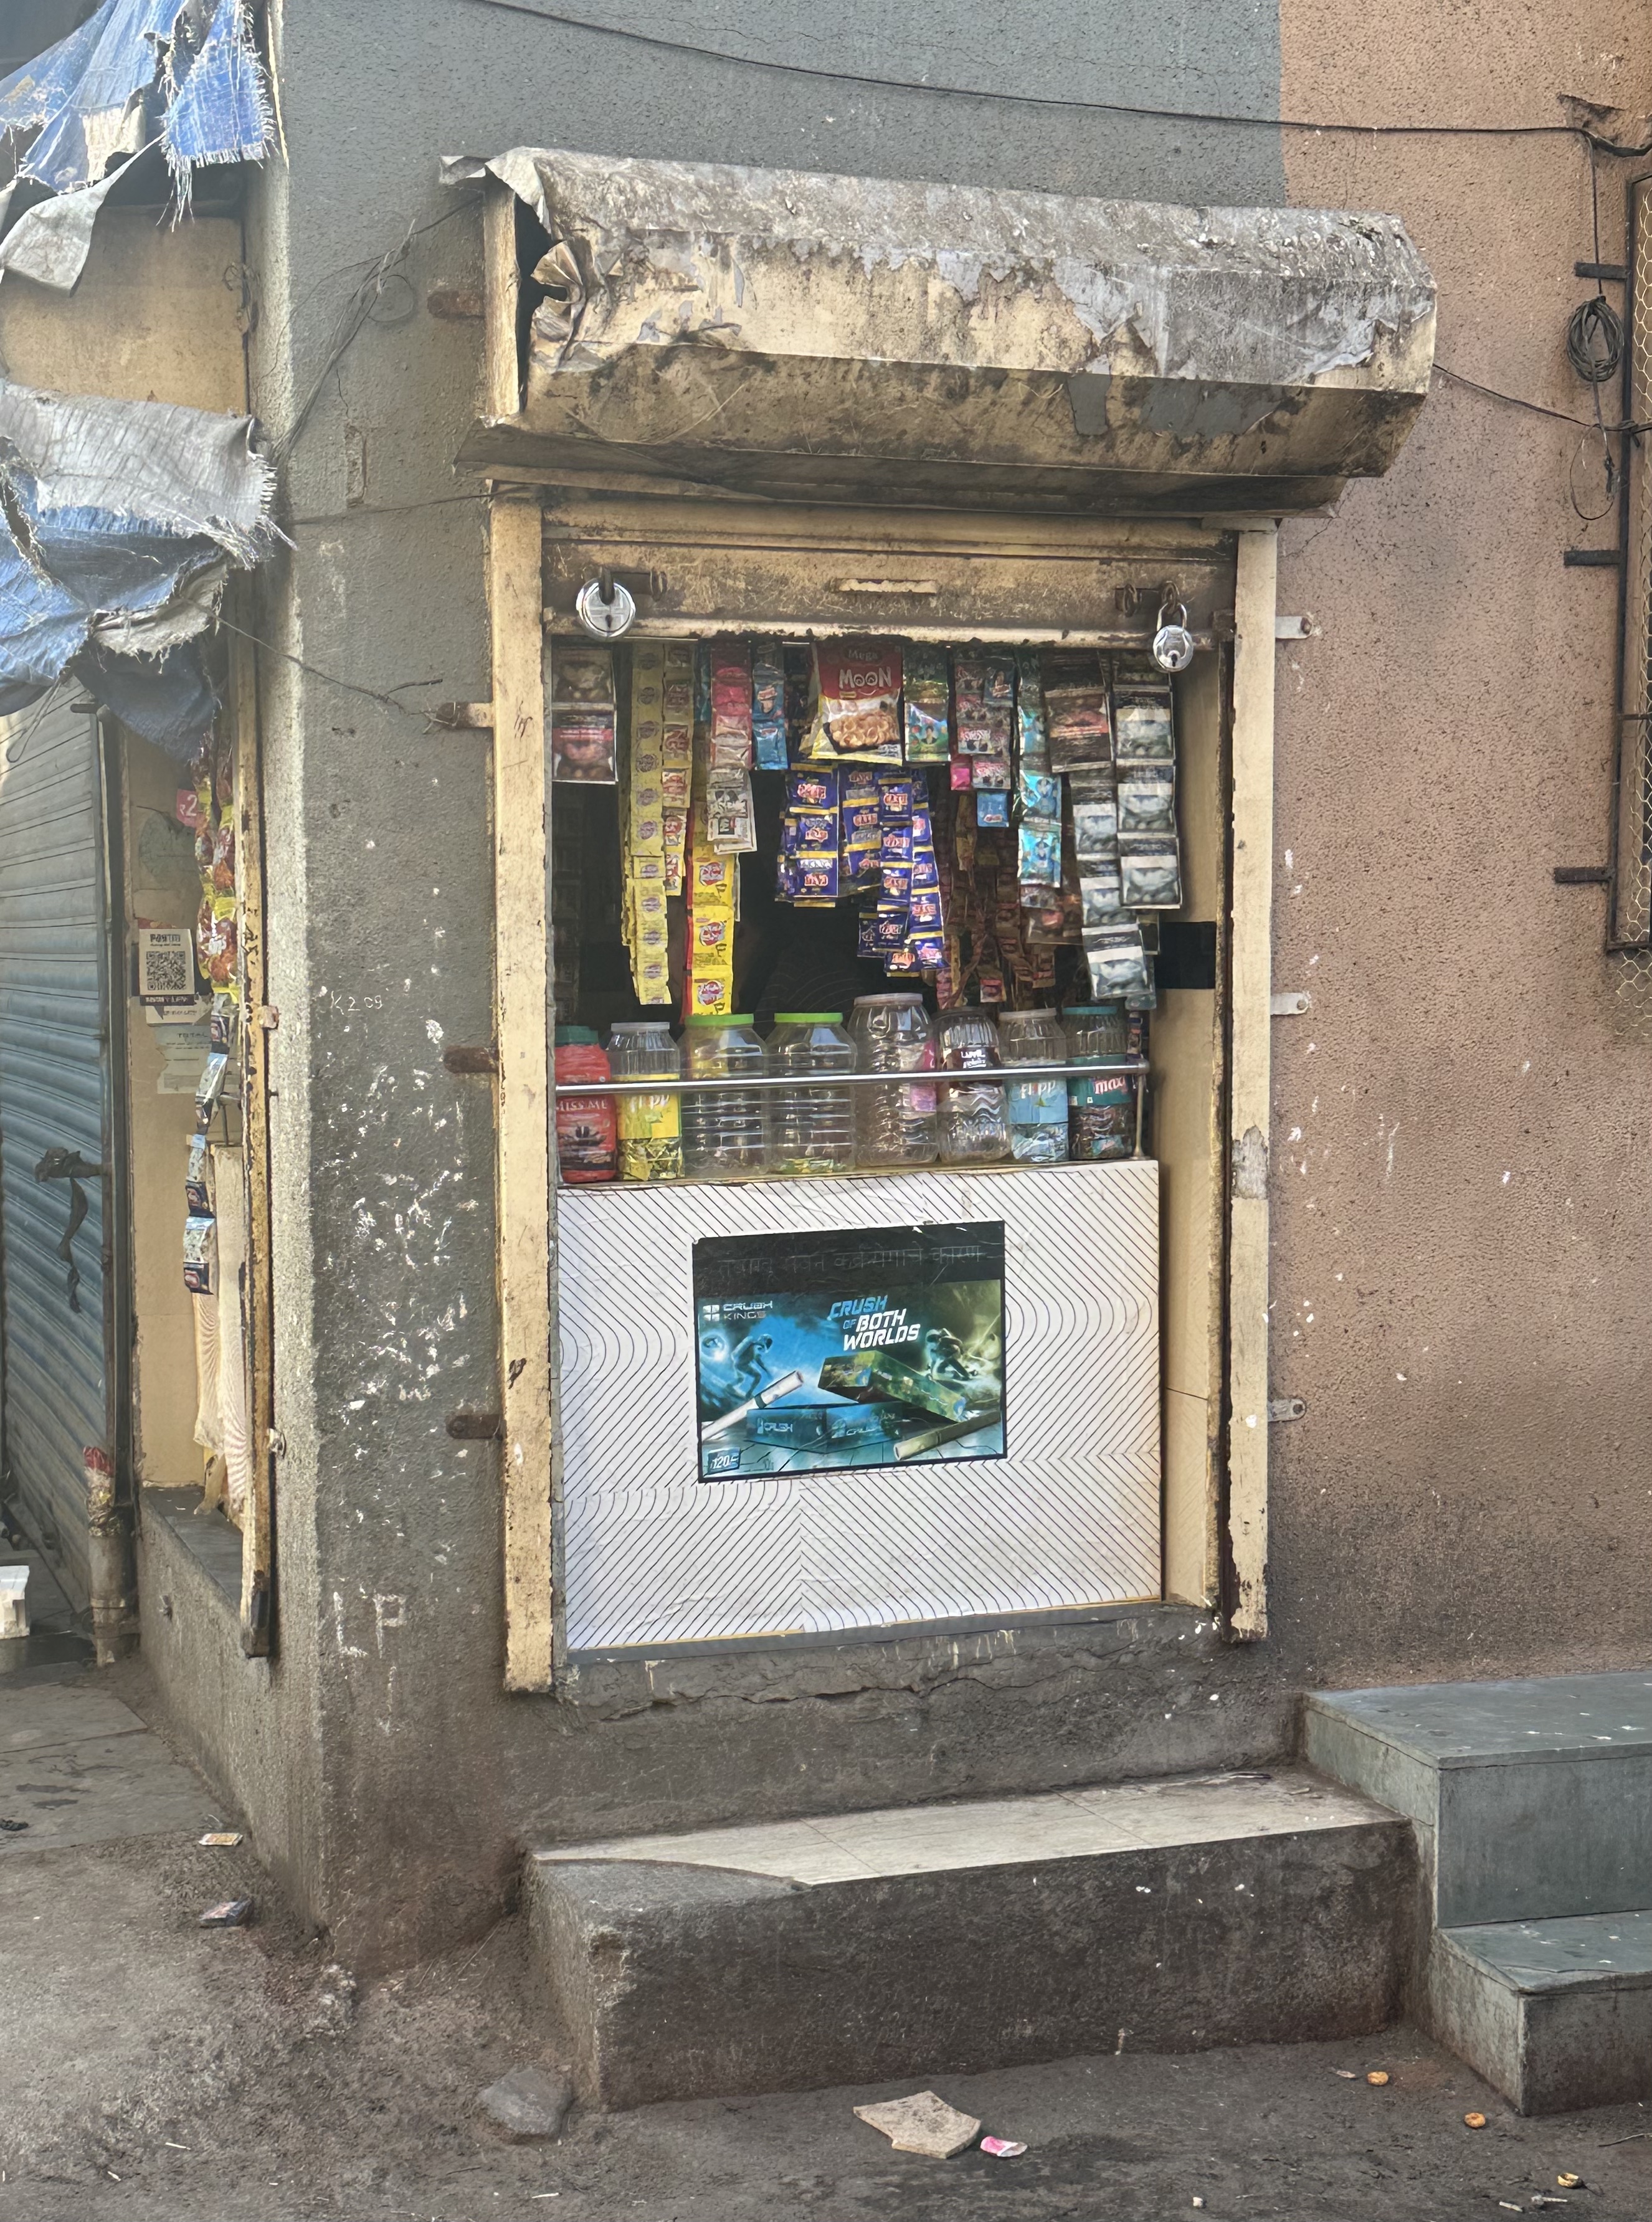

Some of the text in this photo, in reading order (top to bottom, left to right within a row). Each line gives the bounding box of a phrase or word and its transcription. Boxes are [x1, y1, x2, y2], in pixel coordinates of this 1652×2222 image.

[839, 666, 892, 690] MOON
[827, 1294, 888, 1321] CRUSH
[843, 1308, 907, 1332] OF BOTH
[843, 1324, 921, 1351] WORLDS
